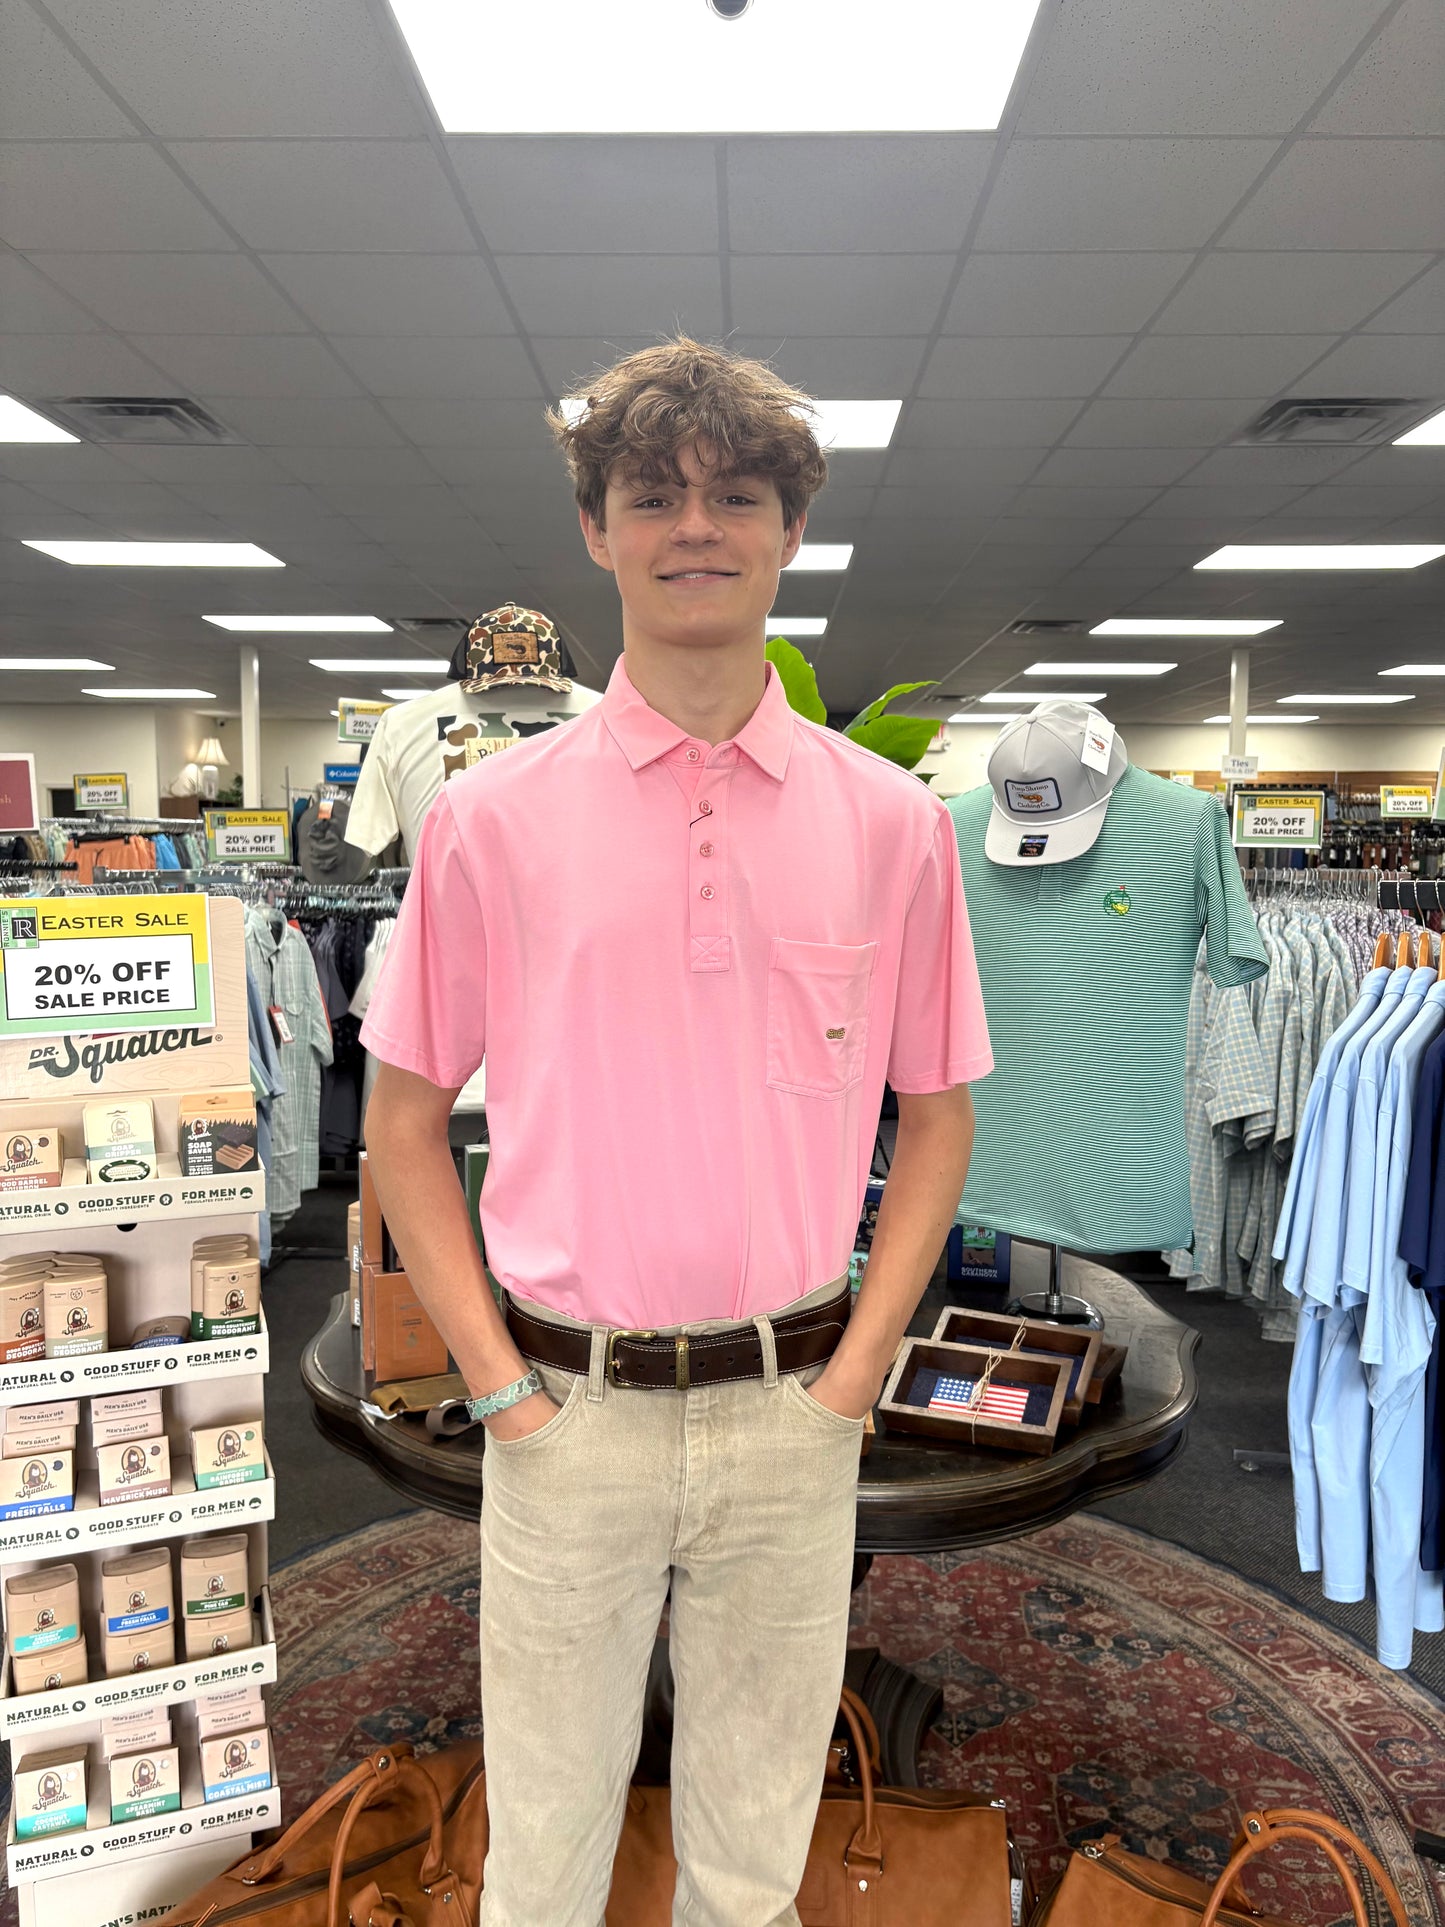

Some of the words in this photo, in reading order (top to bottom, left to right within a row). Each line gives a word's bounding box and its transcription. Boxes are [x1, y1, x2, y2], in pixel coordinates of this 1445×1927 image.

[353, 720, 371, 728] 20%
[1230, 759, 1248, 767] Ties
[1294, 797, 1314, 805] SALE
[262, 815, 282, 823] SALE
[1253, 817, 1278, 826] 20%
[1282, 817, 1306, 826] OFF
[225, 835, 250, 844] 20%
[253, 834, 276, 844] OFF
[249, 845, 276, 853] PRICE
[13, 919, 36, 938] R
[42, 915, 124, 930] EASTER
[135, 912, 189, 927] SALE
[34, 963, 102, 986] 20%
[112, 961, 171, 982] OFF
[35, 992, 95, 1010] SALE
[103, 988, 171, 1006] PRICE
[29, 1046, 60, 1060] DR.
[78, 1198, 113, 1209] GOOD
[116, 1195, 155, 1206] STUFF
[182, 1191, 206, 1200] FOR
[209, 1188, 236, 1197] MEN
[0, 1204, 50, 1216] ATURAL
[212, 1325, 256, 1335] DEODORANT
[53, 1344, 103, 1356] DEODORANT
[187, 1353, 211, 1363] FOR
[214, 1349, 241, 1359] MEN
[84, 1365, 119, 1376] GOOD
[121, 1359, 160, 1372] STUFF
[0, 1372, 56, 1386] ATURAL
[118, 1466, 155, 1484] Squatch
[18, 1481, 56, 1499] Squatch
[103, 1491, 145, 1505] MAVERICK
[146, 1486, 169, 1496] MUSK
[5, 1506, 36, 1519] FRESH
[37, 1503, 66, 1515] FALLS
[191, 1504, 215, 1516] FOR
[218, 1499, 245, 1511] MEN
[89, 1519, 123, 1532] GOOD
[127, 1513, 165, 1526] STUFF
[0, 1530, 61, 1546] NATURAL
[194, 1672, 218, 1683] FOR
[221, 1664, 248, 1678] MEN
[95, 1691, 128, 1704] GOOD
[131, 1683, 169, 1697] STUFF
[7, 1704, 68, 1721] NATURAL
[129, 1779, 165, 1798] Squatch
[208, 1785, 245, 1800] COASTAL
[246, 1780, 267, 1790] MIST
[35, 1792, 69, 1811] Squatch
[126, 1800, 166, 1814] SPEARMINT
[136, 1808, 155, 1817] BASIL
[201, 1815, 224, 1827] FOR
[227, 1807, 253, 1820] MEN
[103, 1835, 136, 1848] GOOD
[139, 1826, 176, 1841] STUFF
[15, 1848, 77, 1868] NATURAL
